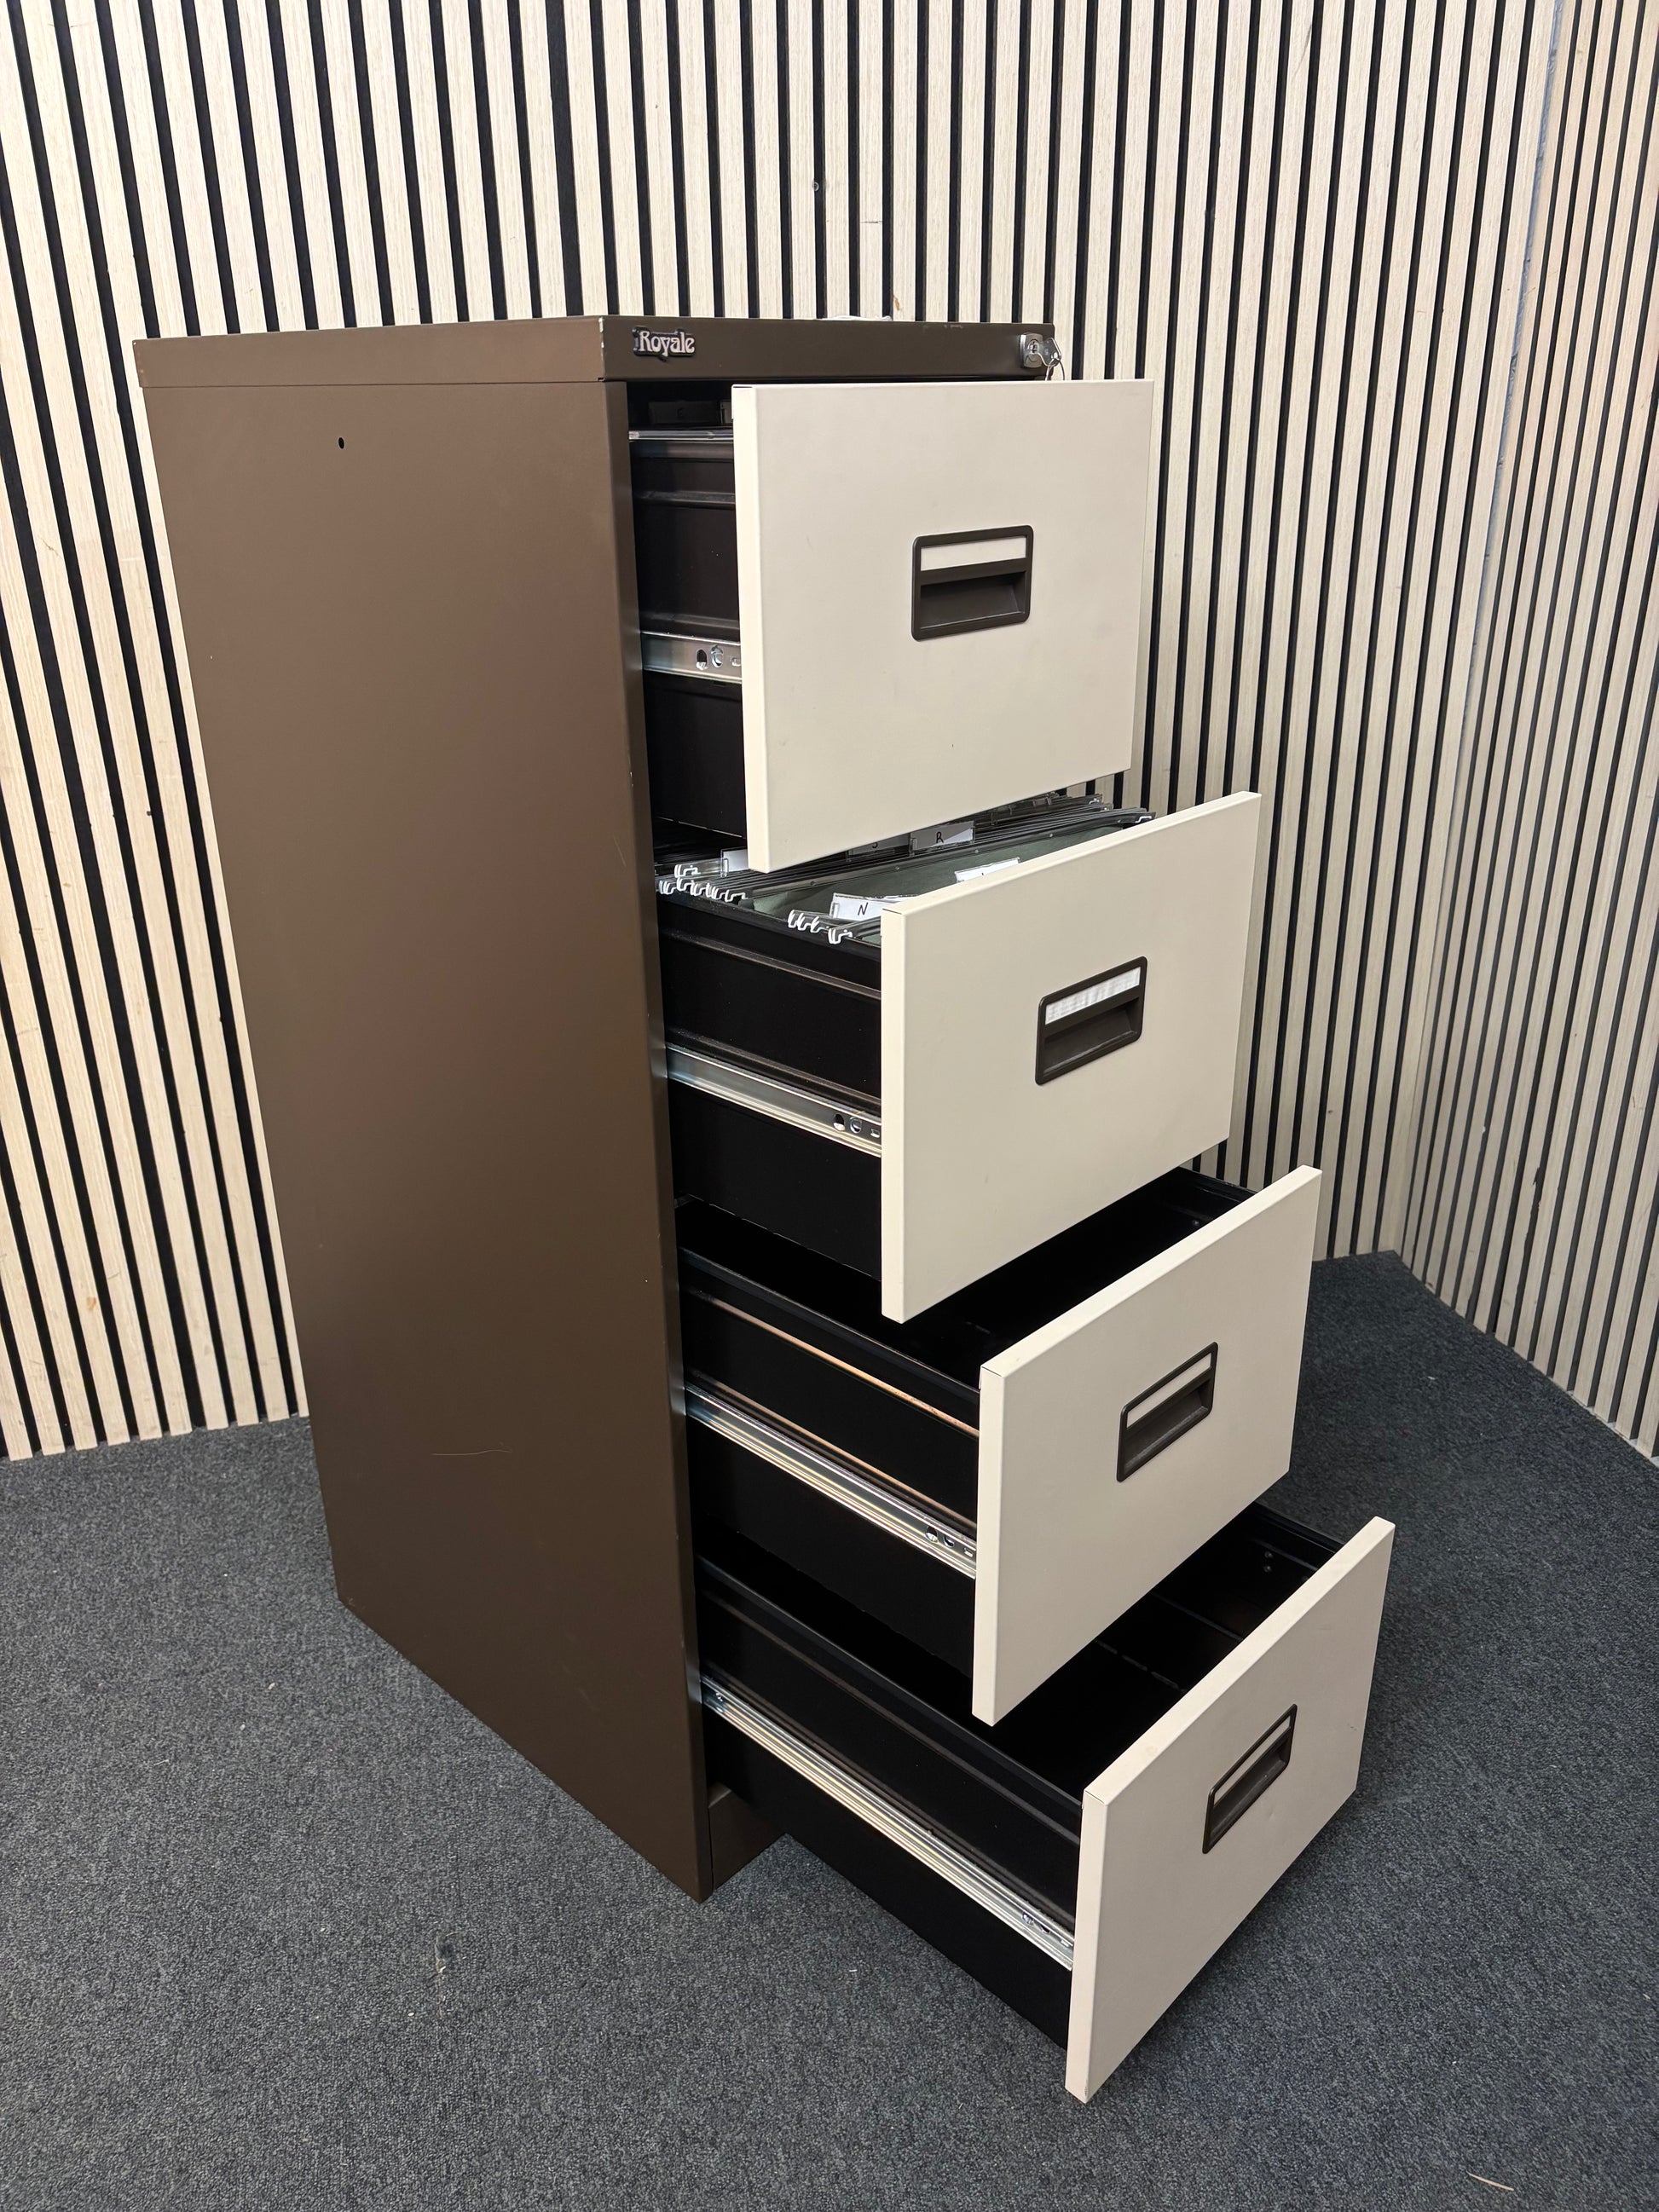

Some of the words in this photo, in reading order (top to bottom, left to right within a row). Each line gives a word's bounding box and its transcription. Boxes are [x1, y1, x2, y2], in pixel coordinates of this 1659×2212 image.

[638, 330, 696, 357] Royale
[935, 831, 945, 844] R
[857, 901, 869, 916] N
